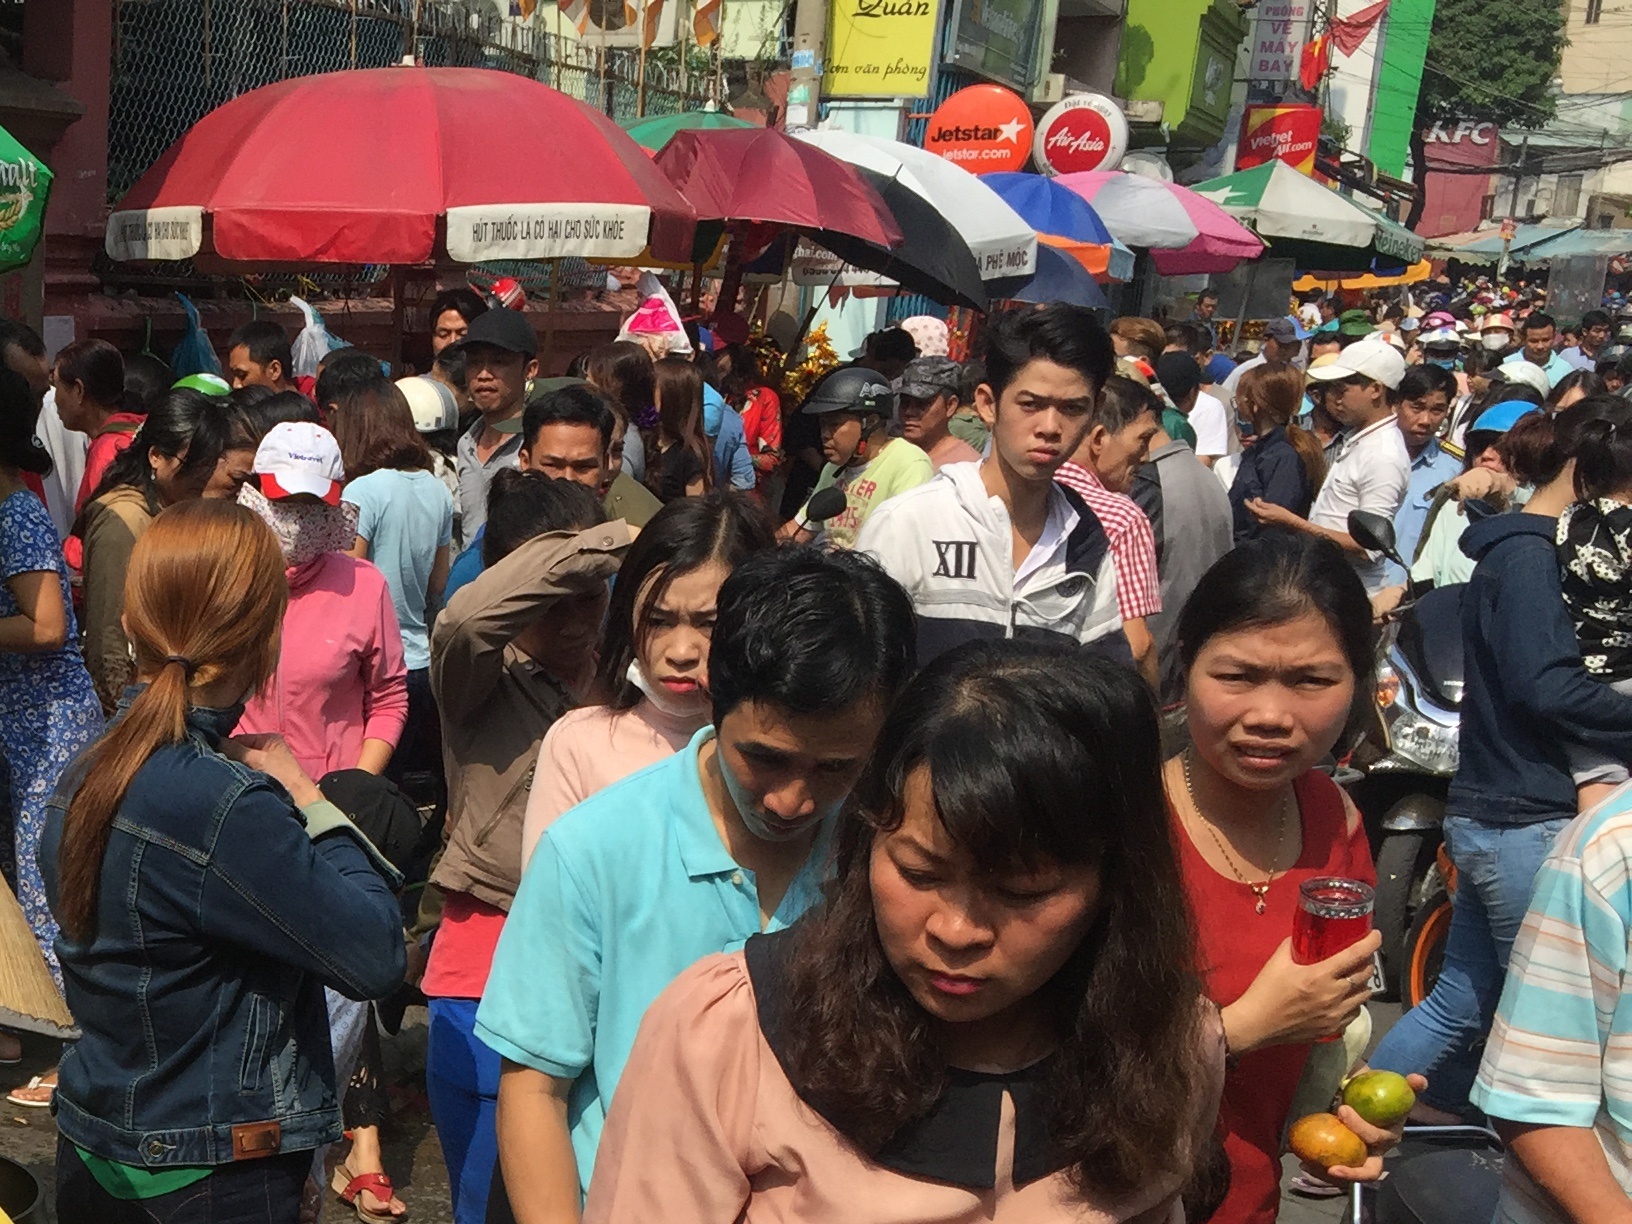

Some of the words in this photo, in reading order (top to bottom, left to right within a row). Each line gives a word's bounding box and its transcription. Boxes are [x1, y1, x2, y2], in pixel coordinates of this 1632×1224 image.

[1260, 38, 1299, 54] MÁY
[882, 58, 927, 81] phòng
[1258, 59, 1294, 72] BAY
[931, 124, 1002, 142] Jetstar
[1426, 120, 1494, 145] KFC
[564, 219, 581, 240] CHO
[931, 540, 979, 580] XII
